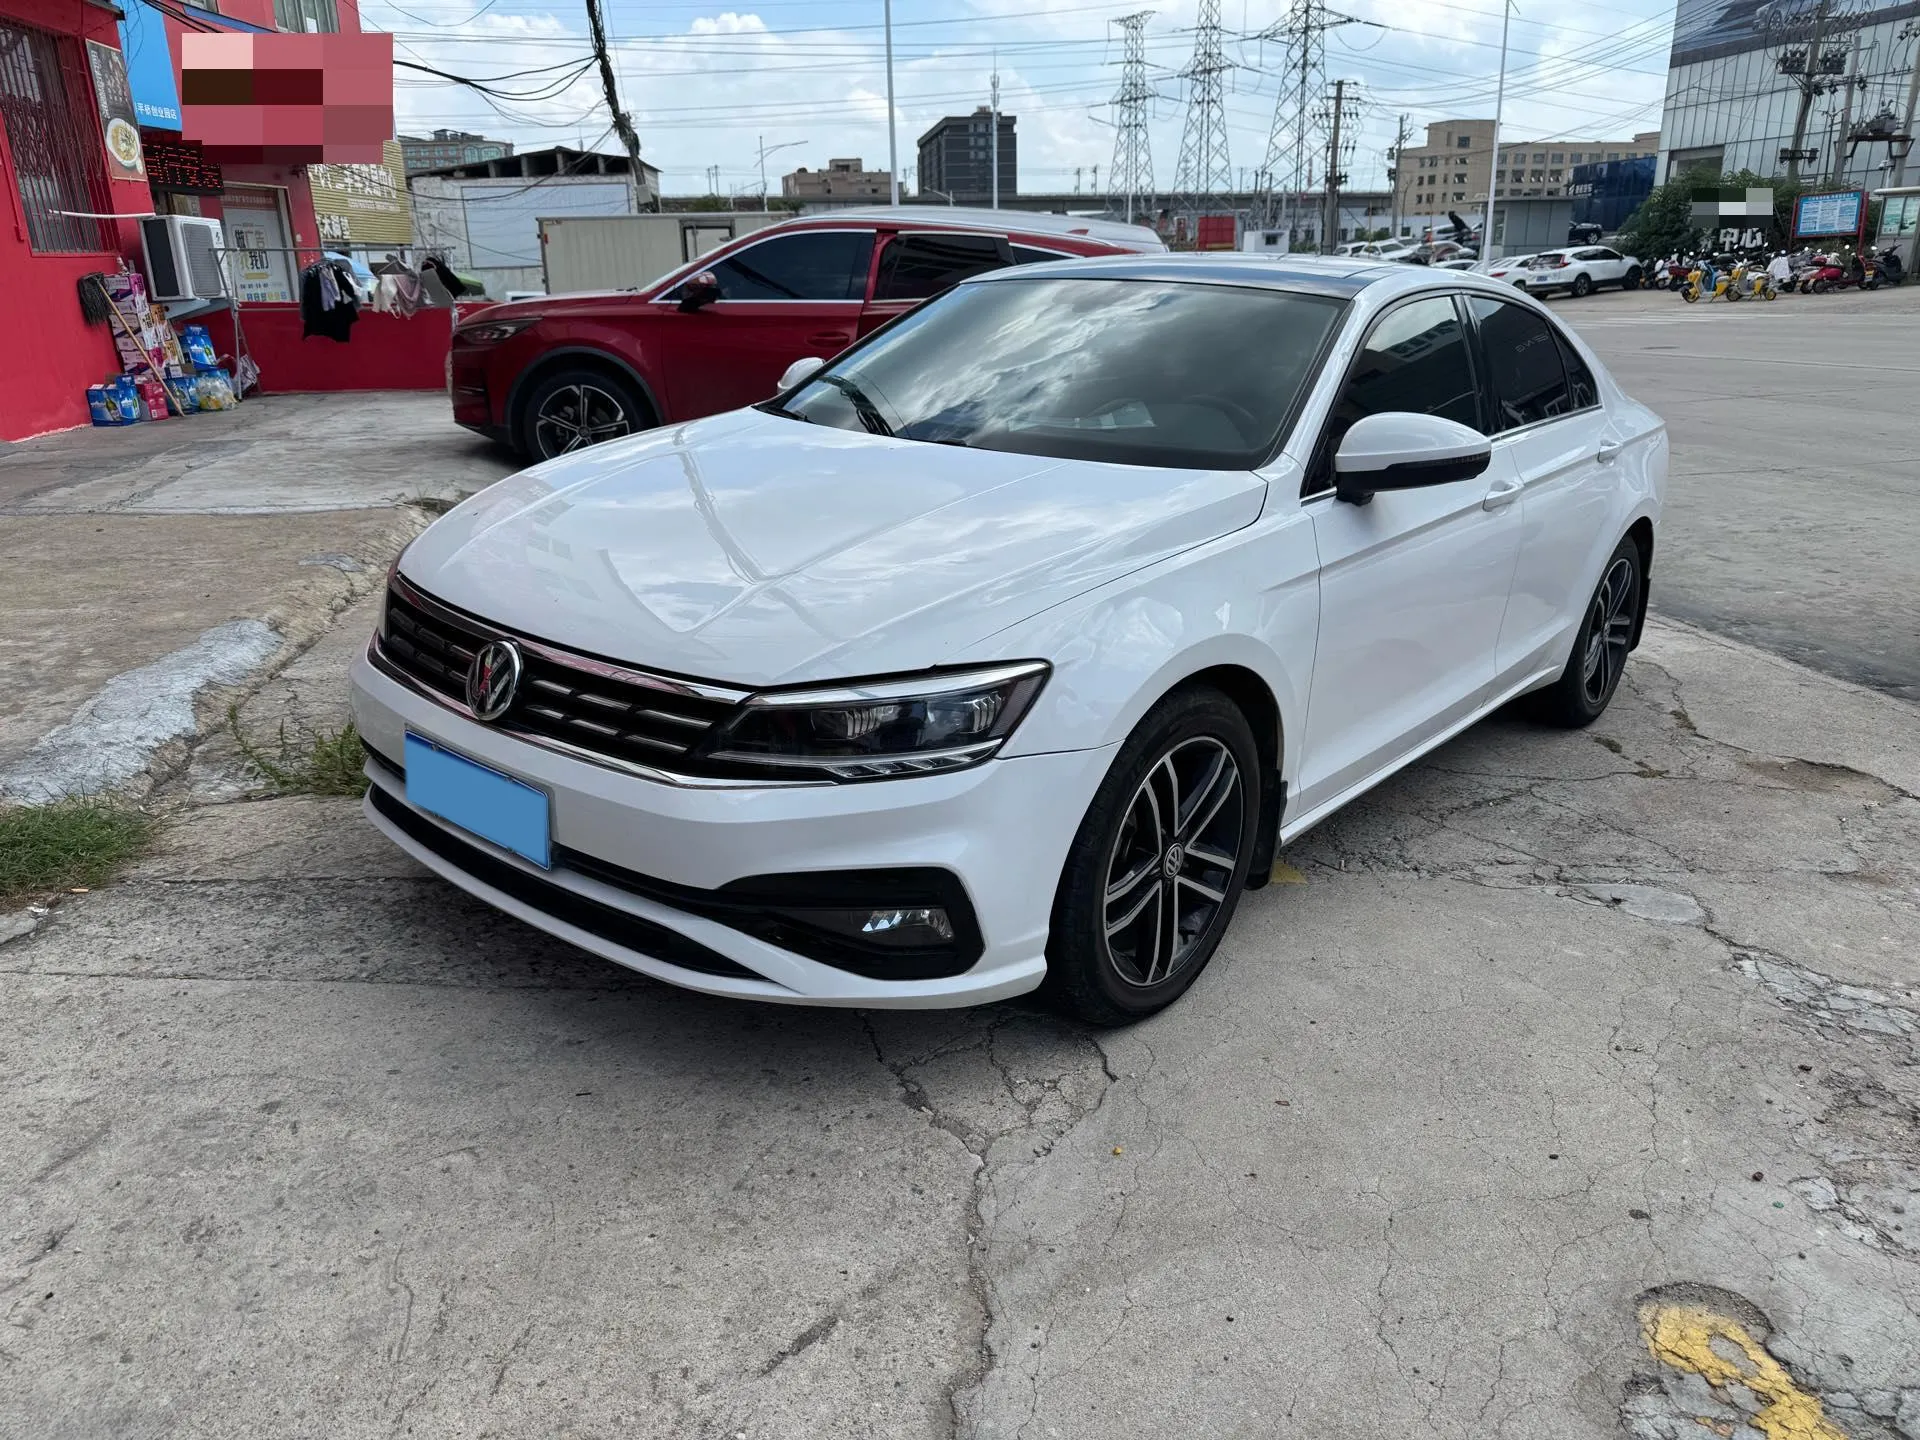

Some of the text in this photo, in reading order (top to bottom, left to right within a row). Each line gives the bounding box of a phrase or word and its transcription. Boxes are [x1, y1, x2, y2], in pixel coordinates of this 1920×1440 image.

[134, 101, 178, 121] 平桥创业园店
